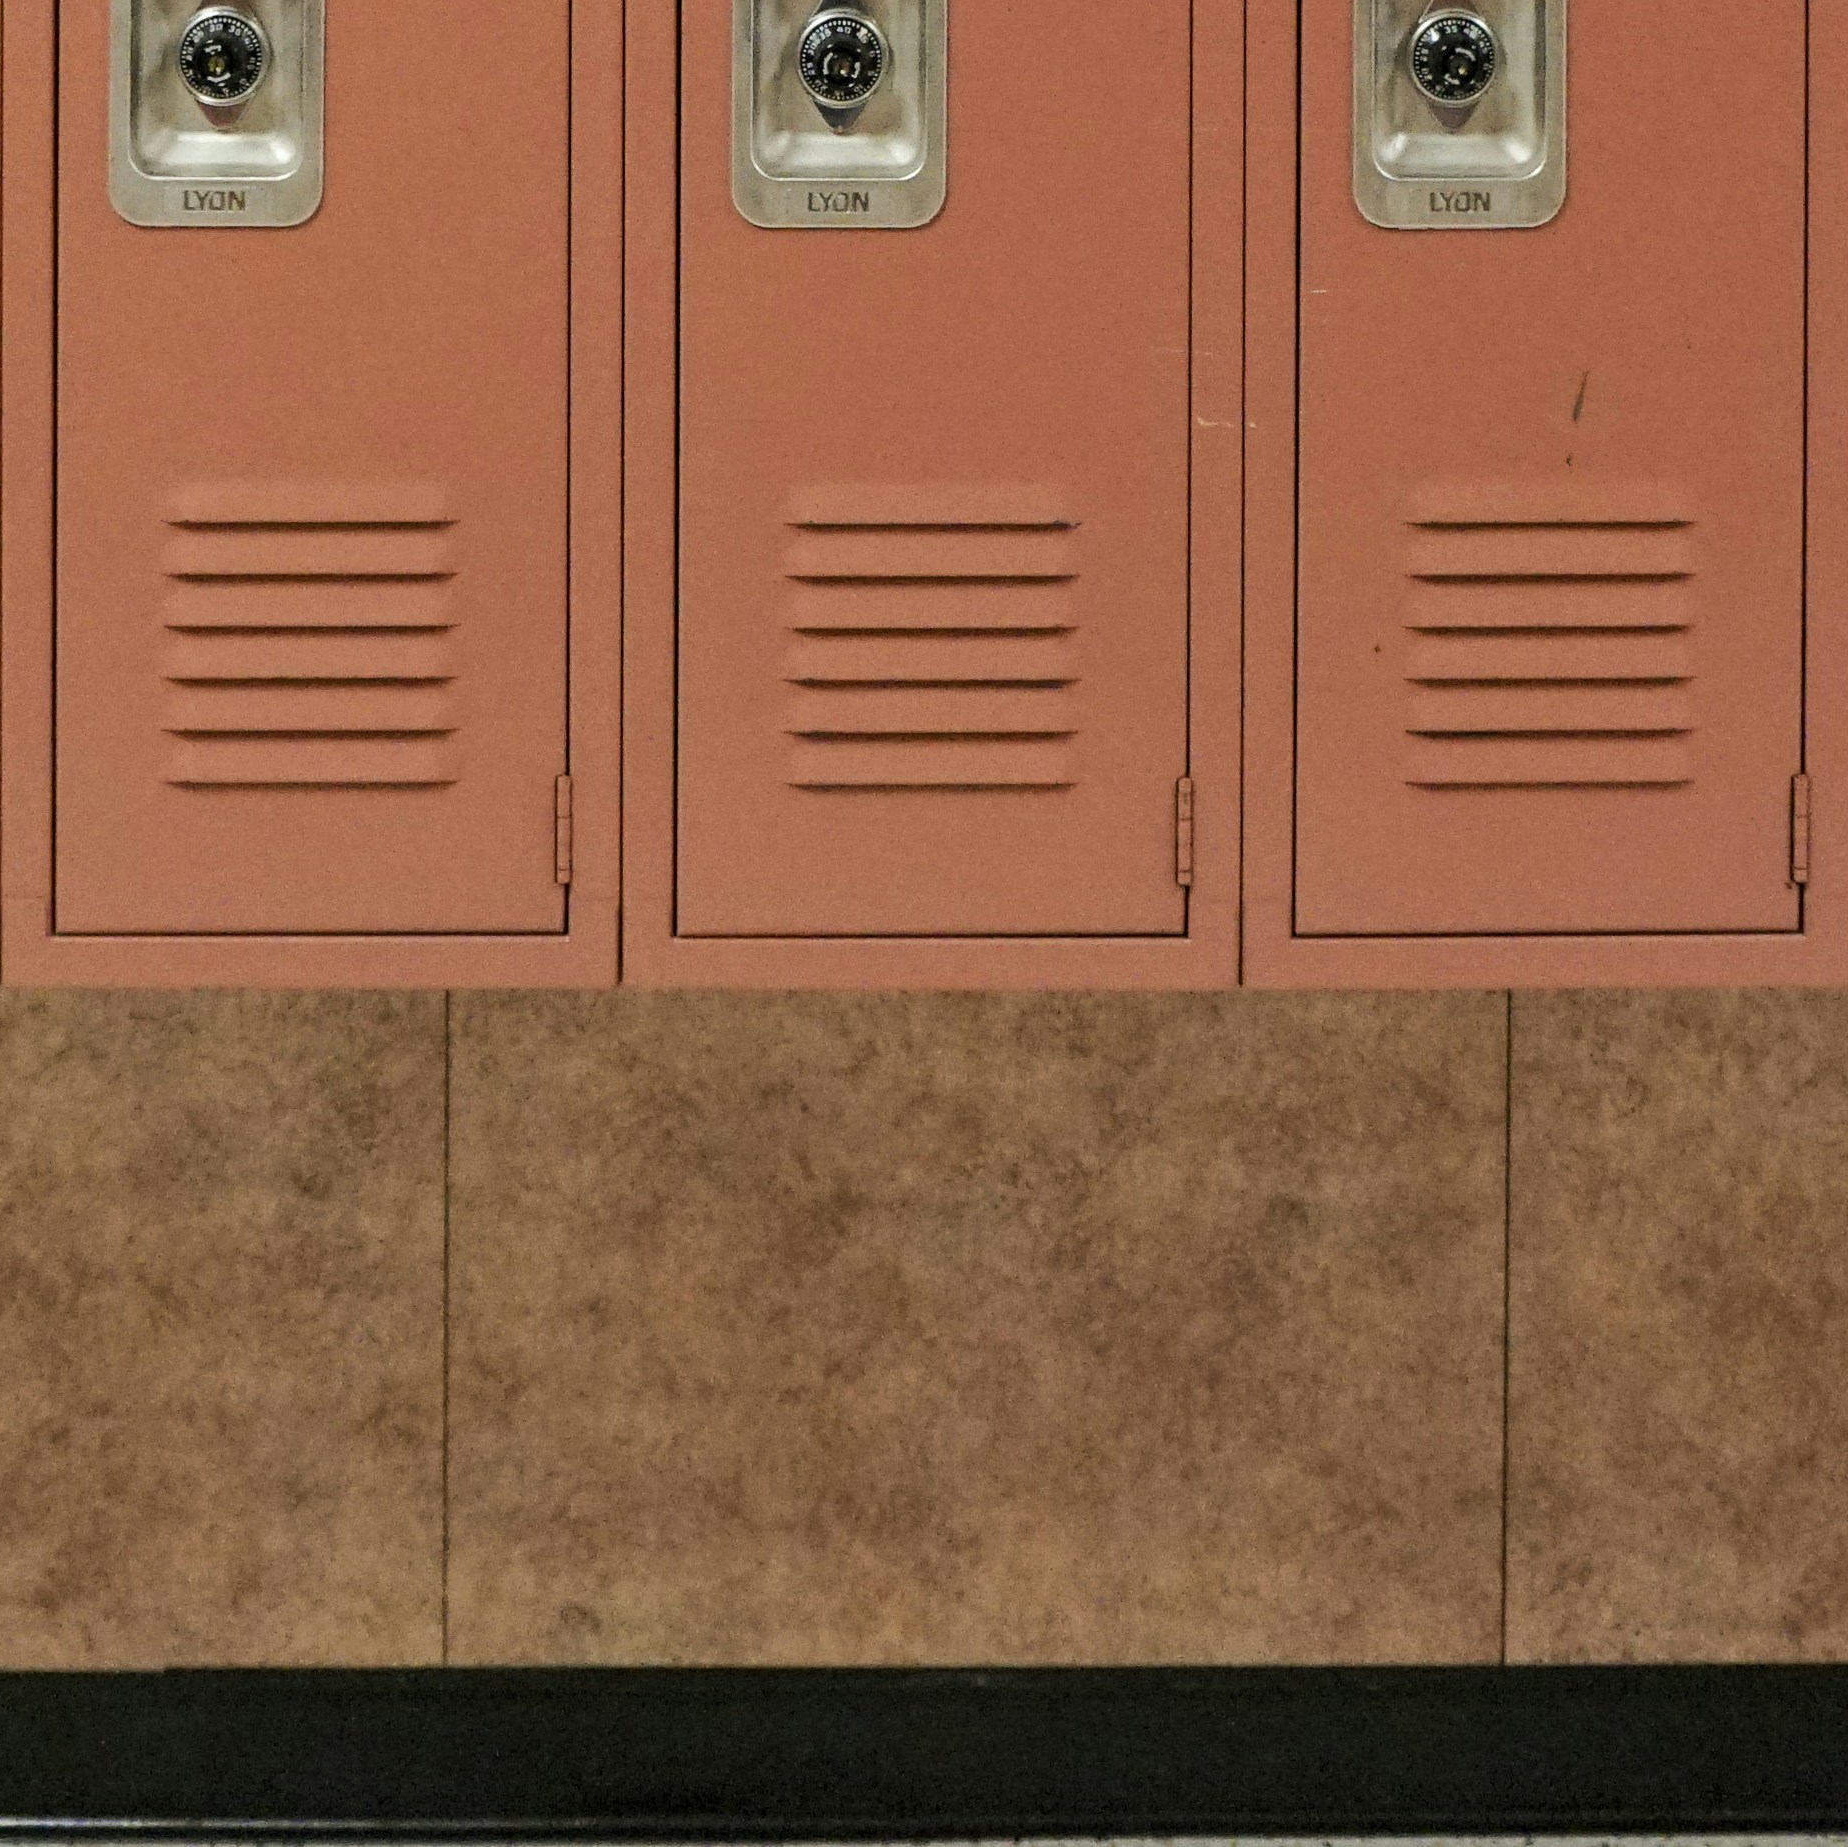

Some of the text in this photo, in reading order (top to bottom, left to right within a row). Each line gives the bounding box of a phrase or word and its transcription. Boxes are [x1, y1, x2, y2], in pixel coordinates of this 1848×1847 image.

[183, 190, 246, 211] LYON
[808, 192, 869, 211] LYON
[1429, 192, 1490, 212] LYON
